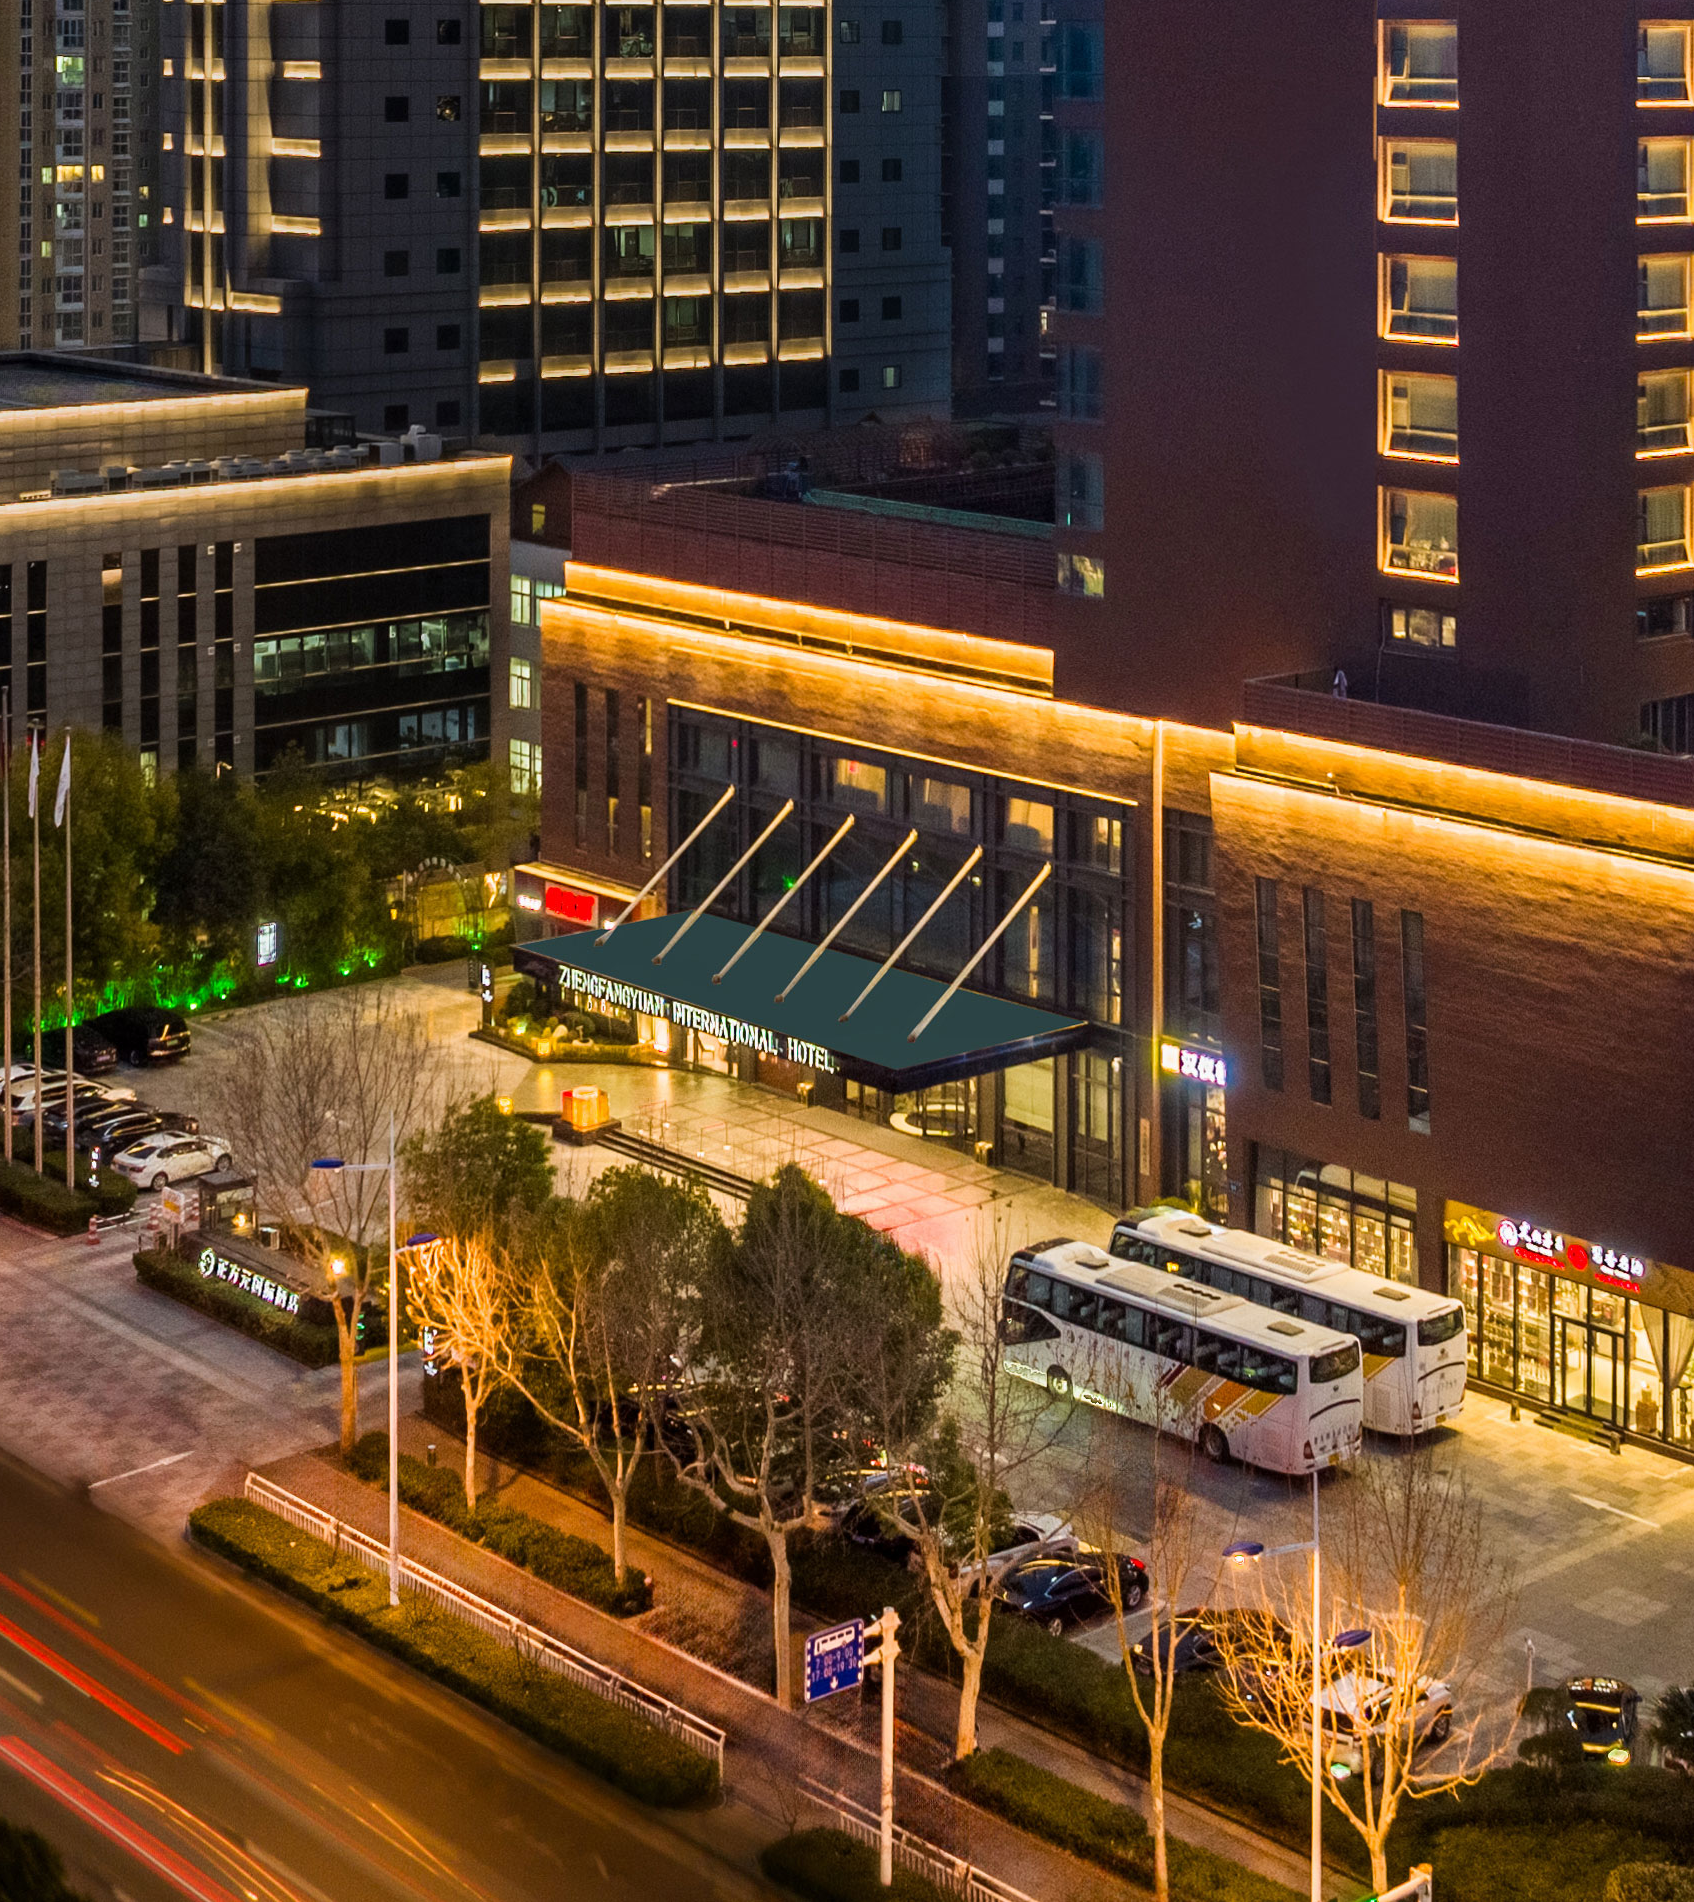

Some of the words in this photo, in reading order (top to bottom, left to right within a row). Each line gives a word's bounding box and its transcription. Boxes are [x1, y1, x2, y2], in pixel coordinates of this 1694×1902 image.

[558, 964, 665, 1018] ZHENGFANGYUAN
[672, 1001, 778, 1056] INTERNATIONAL
[787, 1037, 835, 1074] HOTEL
[216, 1257, 300, 1315] 正方元国际酒店
